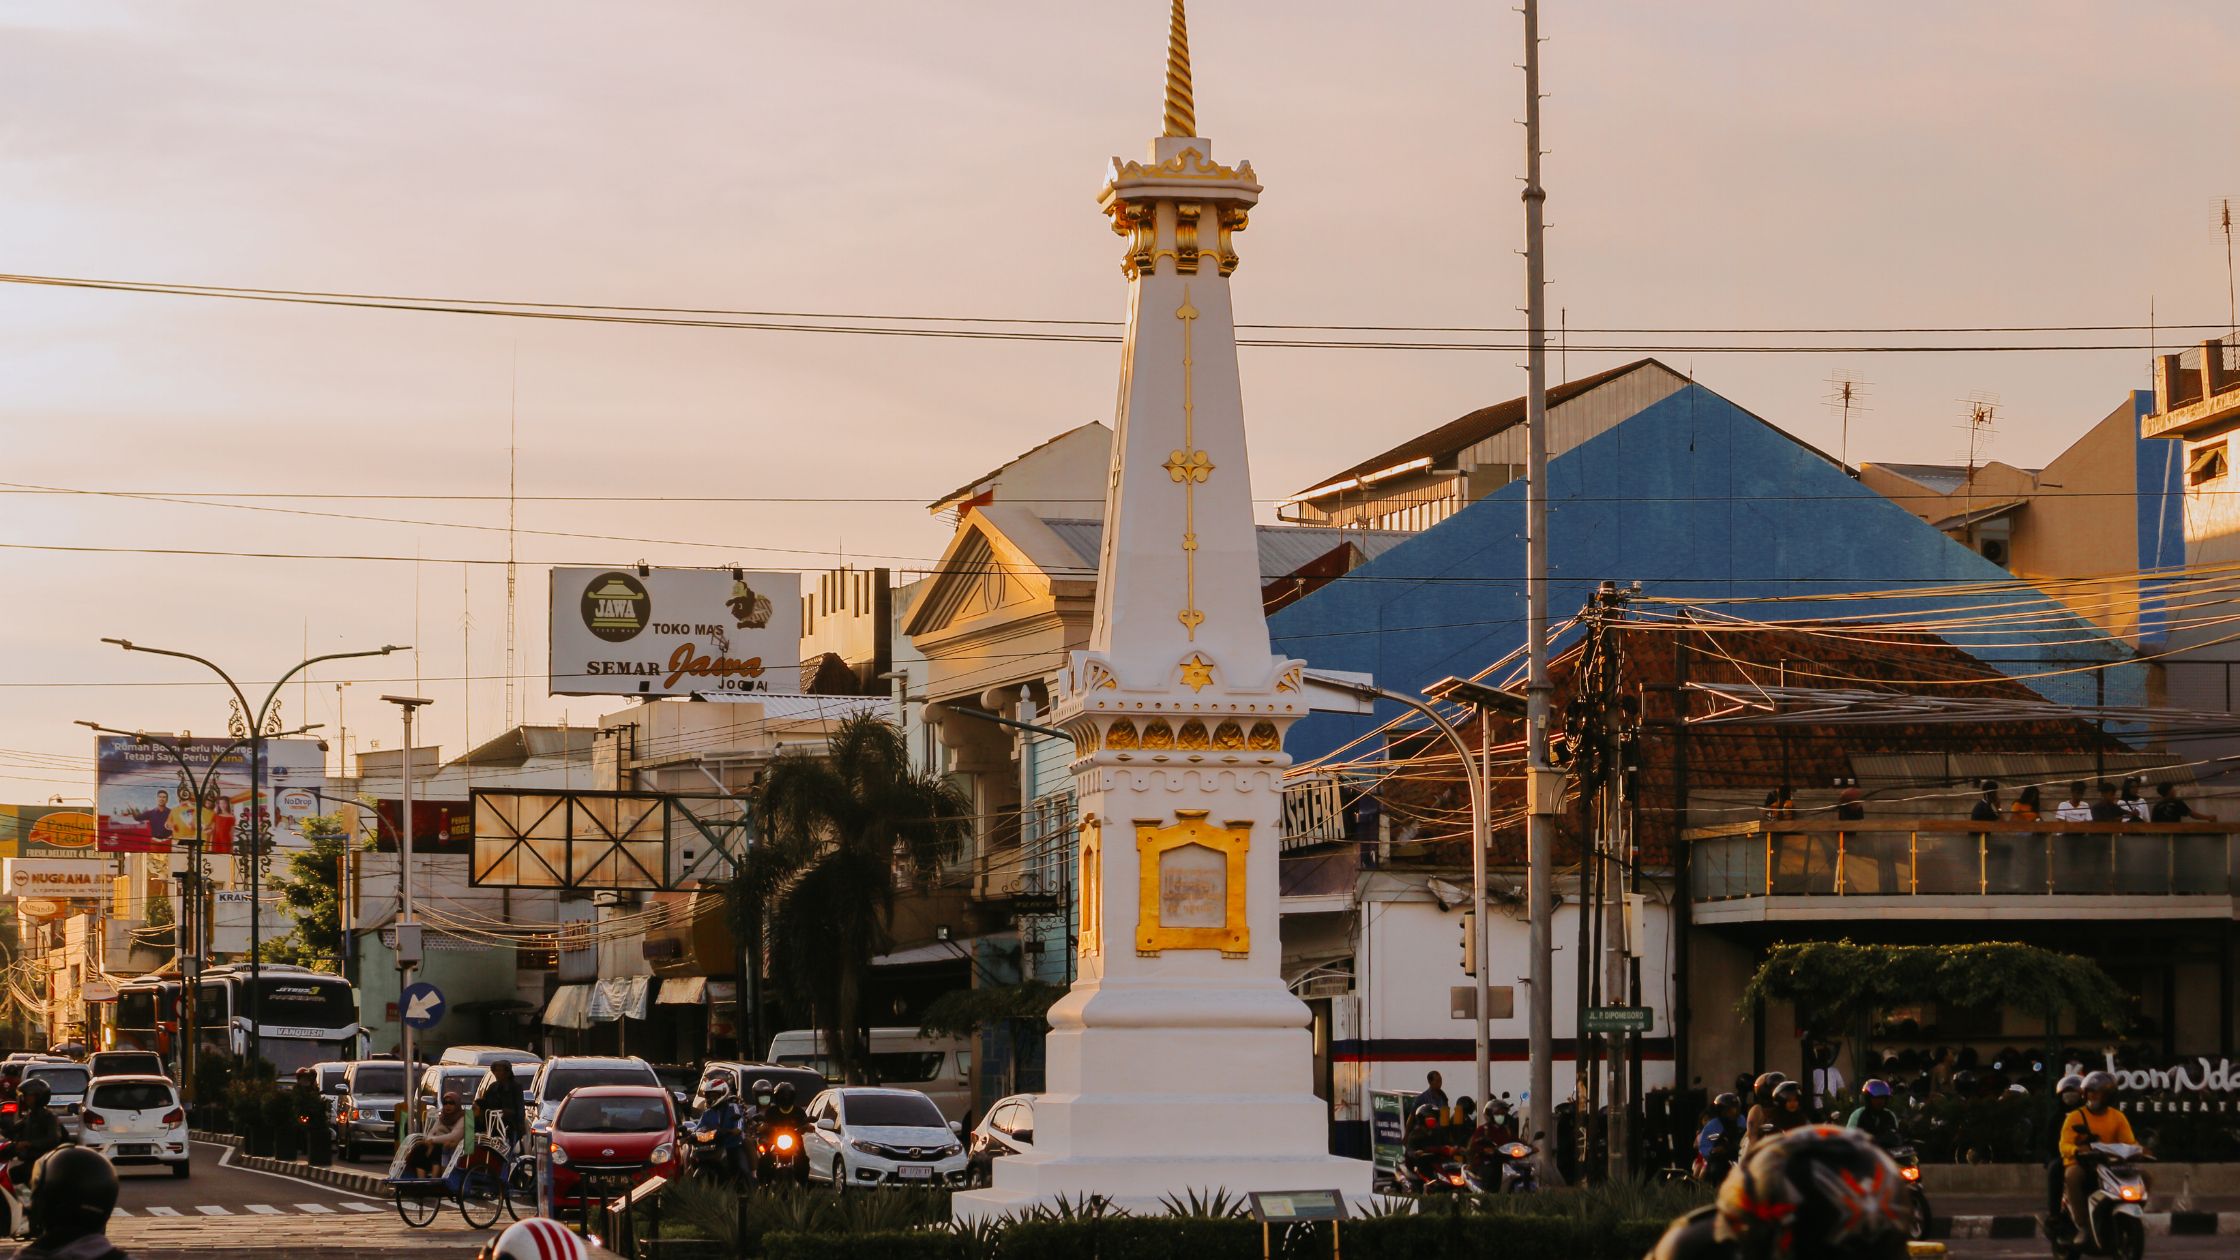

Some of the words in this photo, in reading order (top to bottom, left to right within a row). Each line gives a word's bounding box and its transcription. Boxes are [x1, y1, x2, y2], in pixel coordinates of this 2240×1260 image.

[595, 599, 636, 618] JAWA
[653, 623, 690, 635] TOKO
[695, 624, 724, 636] MAS
[587, 661, 660, 676] SEMAR
[664, 643, 765, 689] Jawa
[183, 754, 209, 762] Perlu
[31, 873, 92, 885] NUGRAHA
